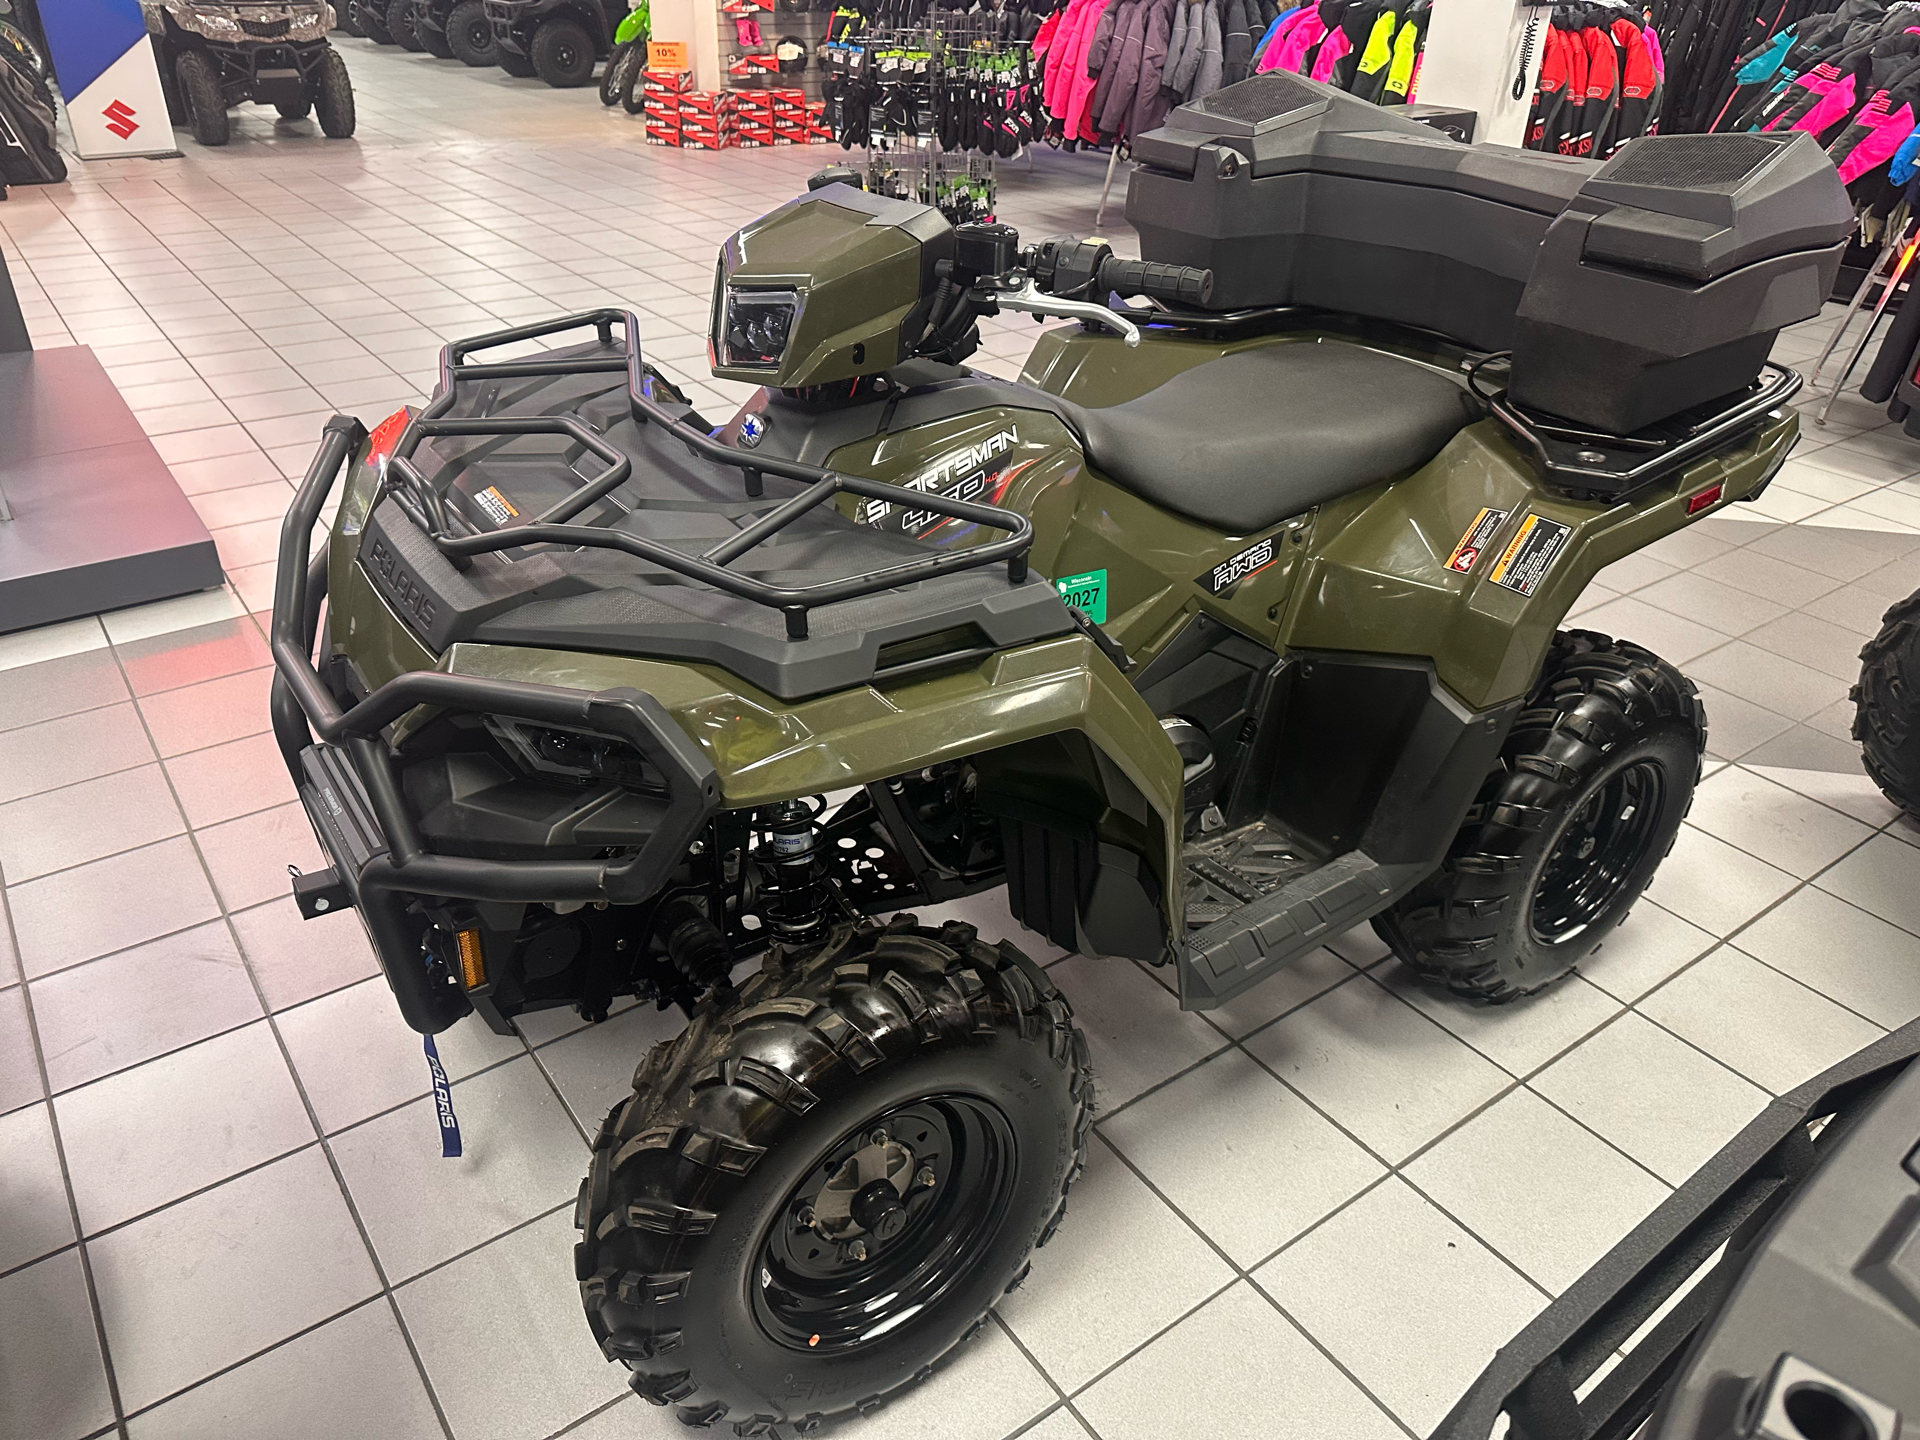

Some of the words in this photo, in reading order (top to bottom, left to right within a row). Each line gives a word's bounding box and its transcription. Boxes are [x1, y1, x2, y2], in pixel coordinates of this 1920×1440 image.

[656, 49, 677, 57] 10%
[1505, 530, 1527, 559] WARNING
[369, 539, 437, 630] POLARIS
[1214, 546, 1272, 591] AWD
[1062, 587, 1100, 608] 2027
[426, 1053, 456, 1129] POLARIS
